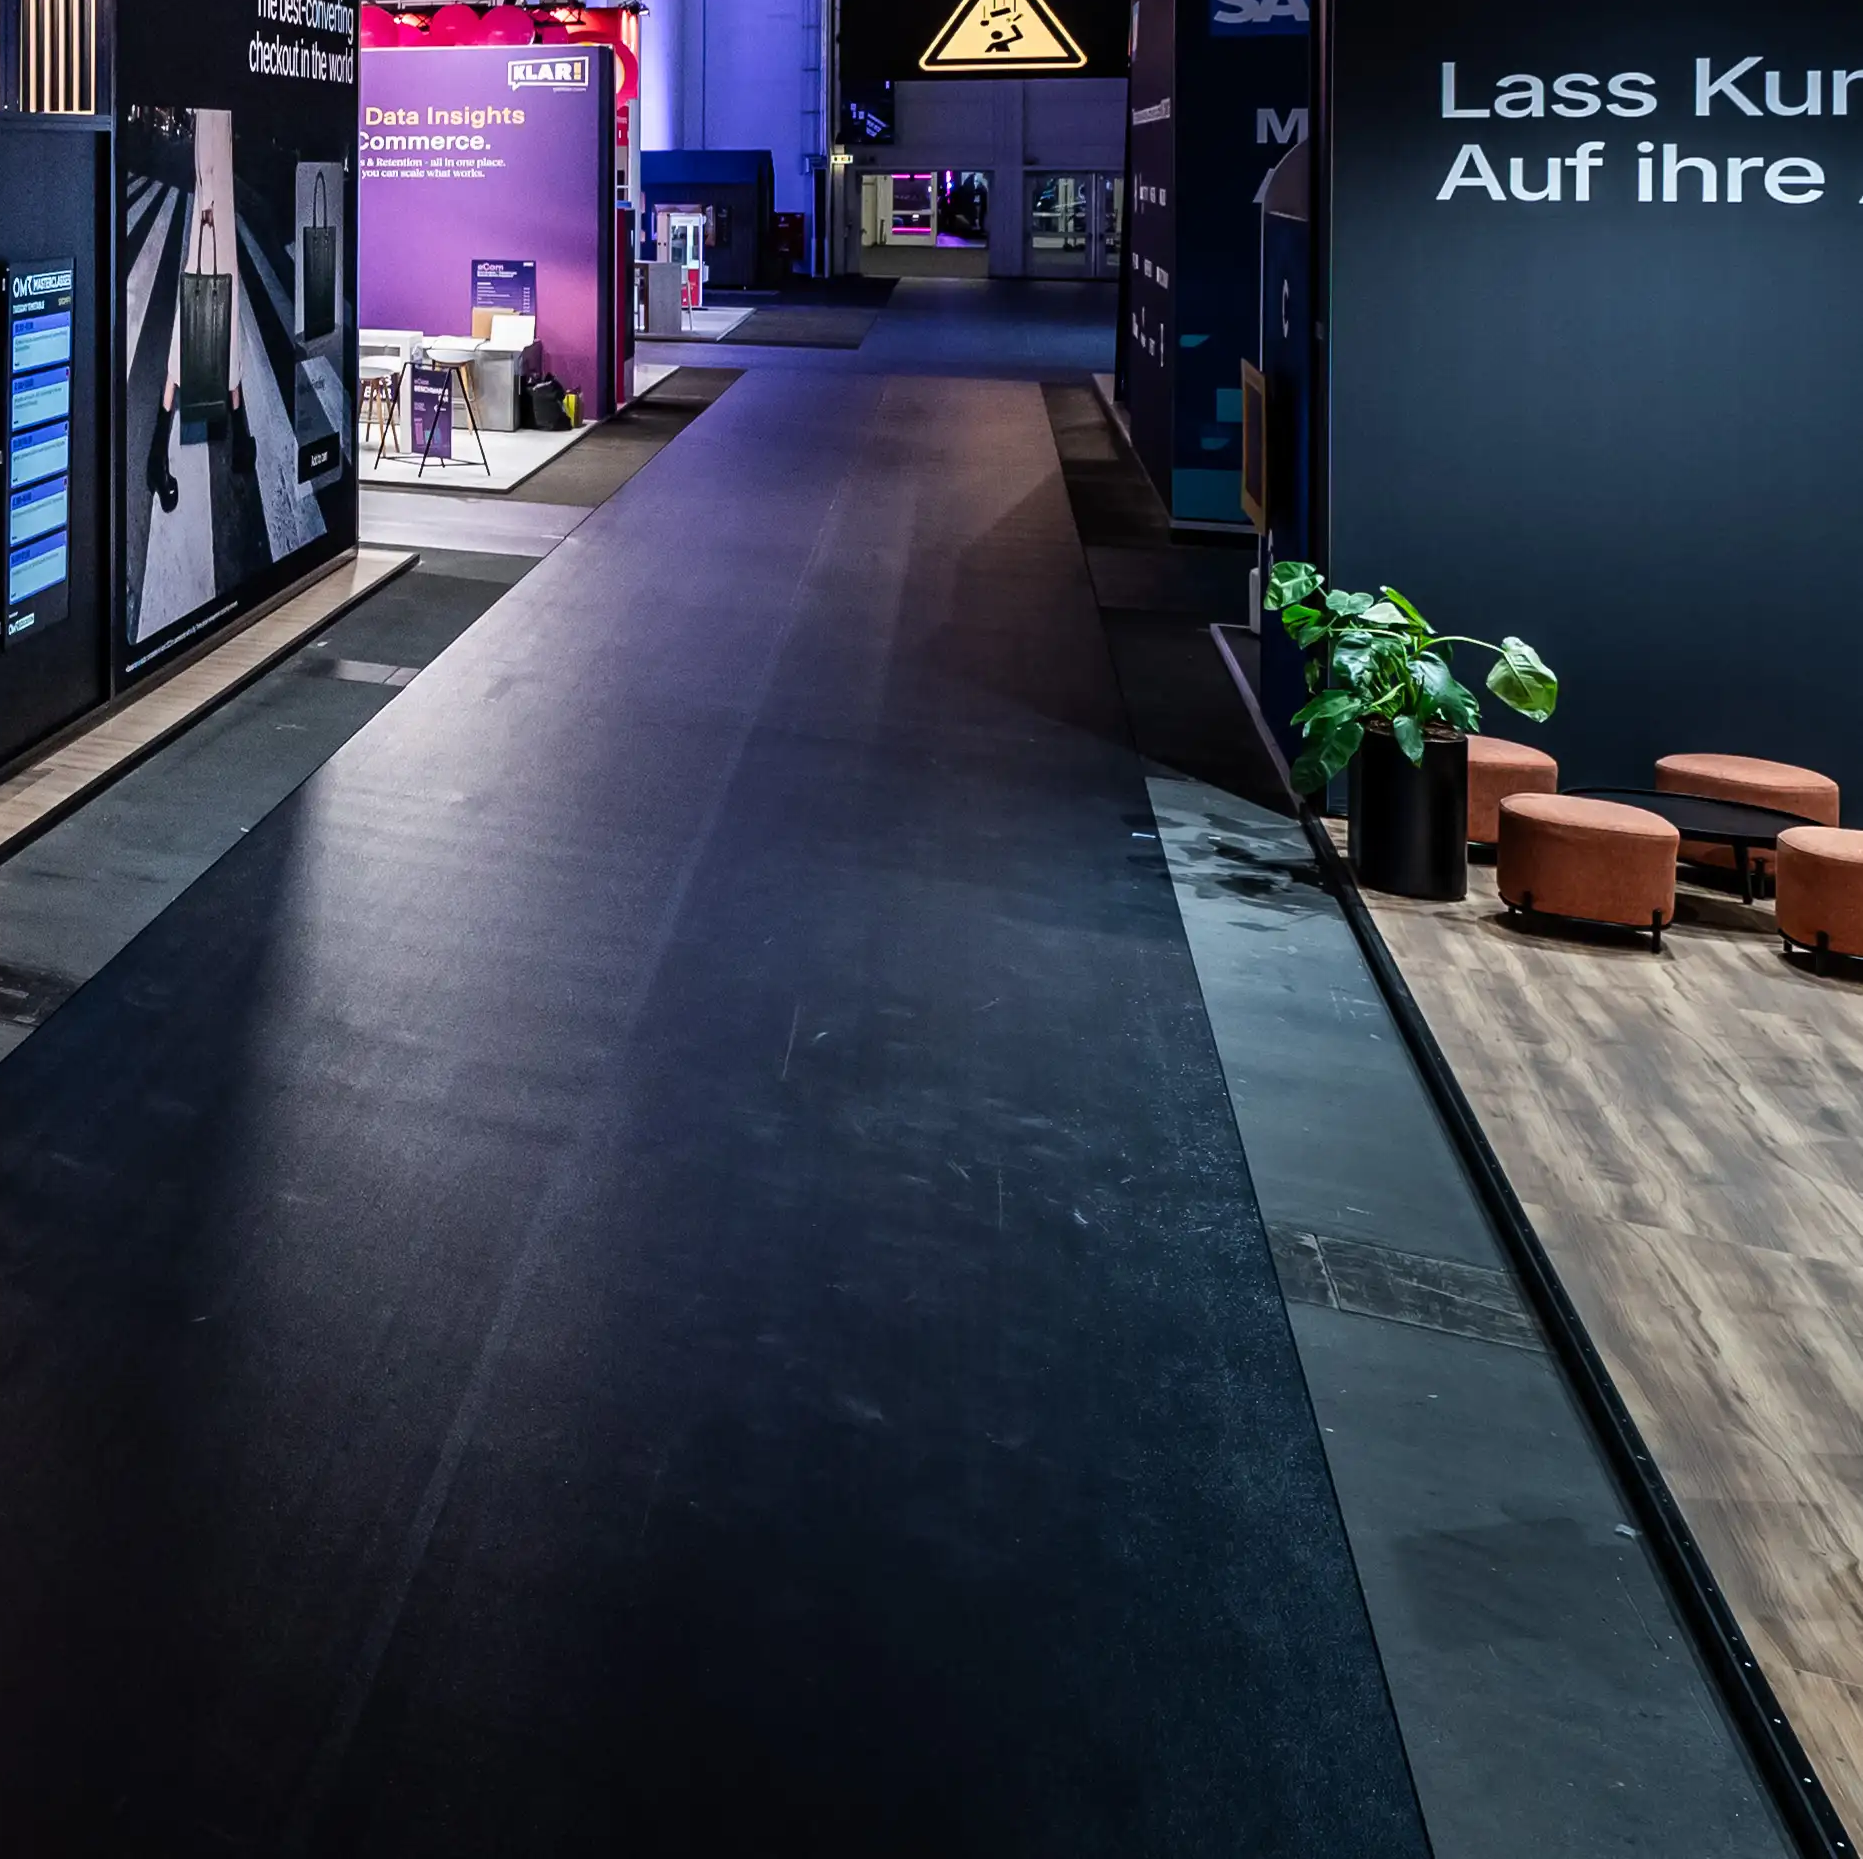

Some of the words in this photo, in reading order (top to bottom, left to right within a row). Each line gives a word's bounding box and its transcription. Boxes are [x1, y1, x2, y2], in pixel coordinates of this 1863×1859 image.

[248, 30, 300, 77] checkout
[300, 38, 310, 78] in
[311, 41, 327, 81] the
[328, 47, 354, 84] world
[513, 62, 582, 81] KLAR!
[1441, 60, 1658, 118] Lass
[365, 106, 420, 125] Data
[427, 106, 525, 129] Insights
[361, 170, 380, 180] you
[381, 170, 399, 178] can
[400, 169, 425, 177] scale
[426, 168, 451, 177] what
[453, 168, 486, 178] works.
[376, 158, 423, 167] Retention
[430, 158, 444, 167] all
[444, 158, 455, 167] in
[456, 159, 475, 167] one
[477, 158, 507, 171] place.
[1435, 141, 1606, 202] Auf
[1637, 141, 1826, 204] ihre
